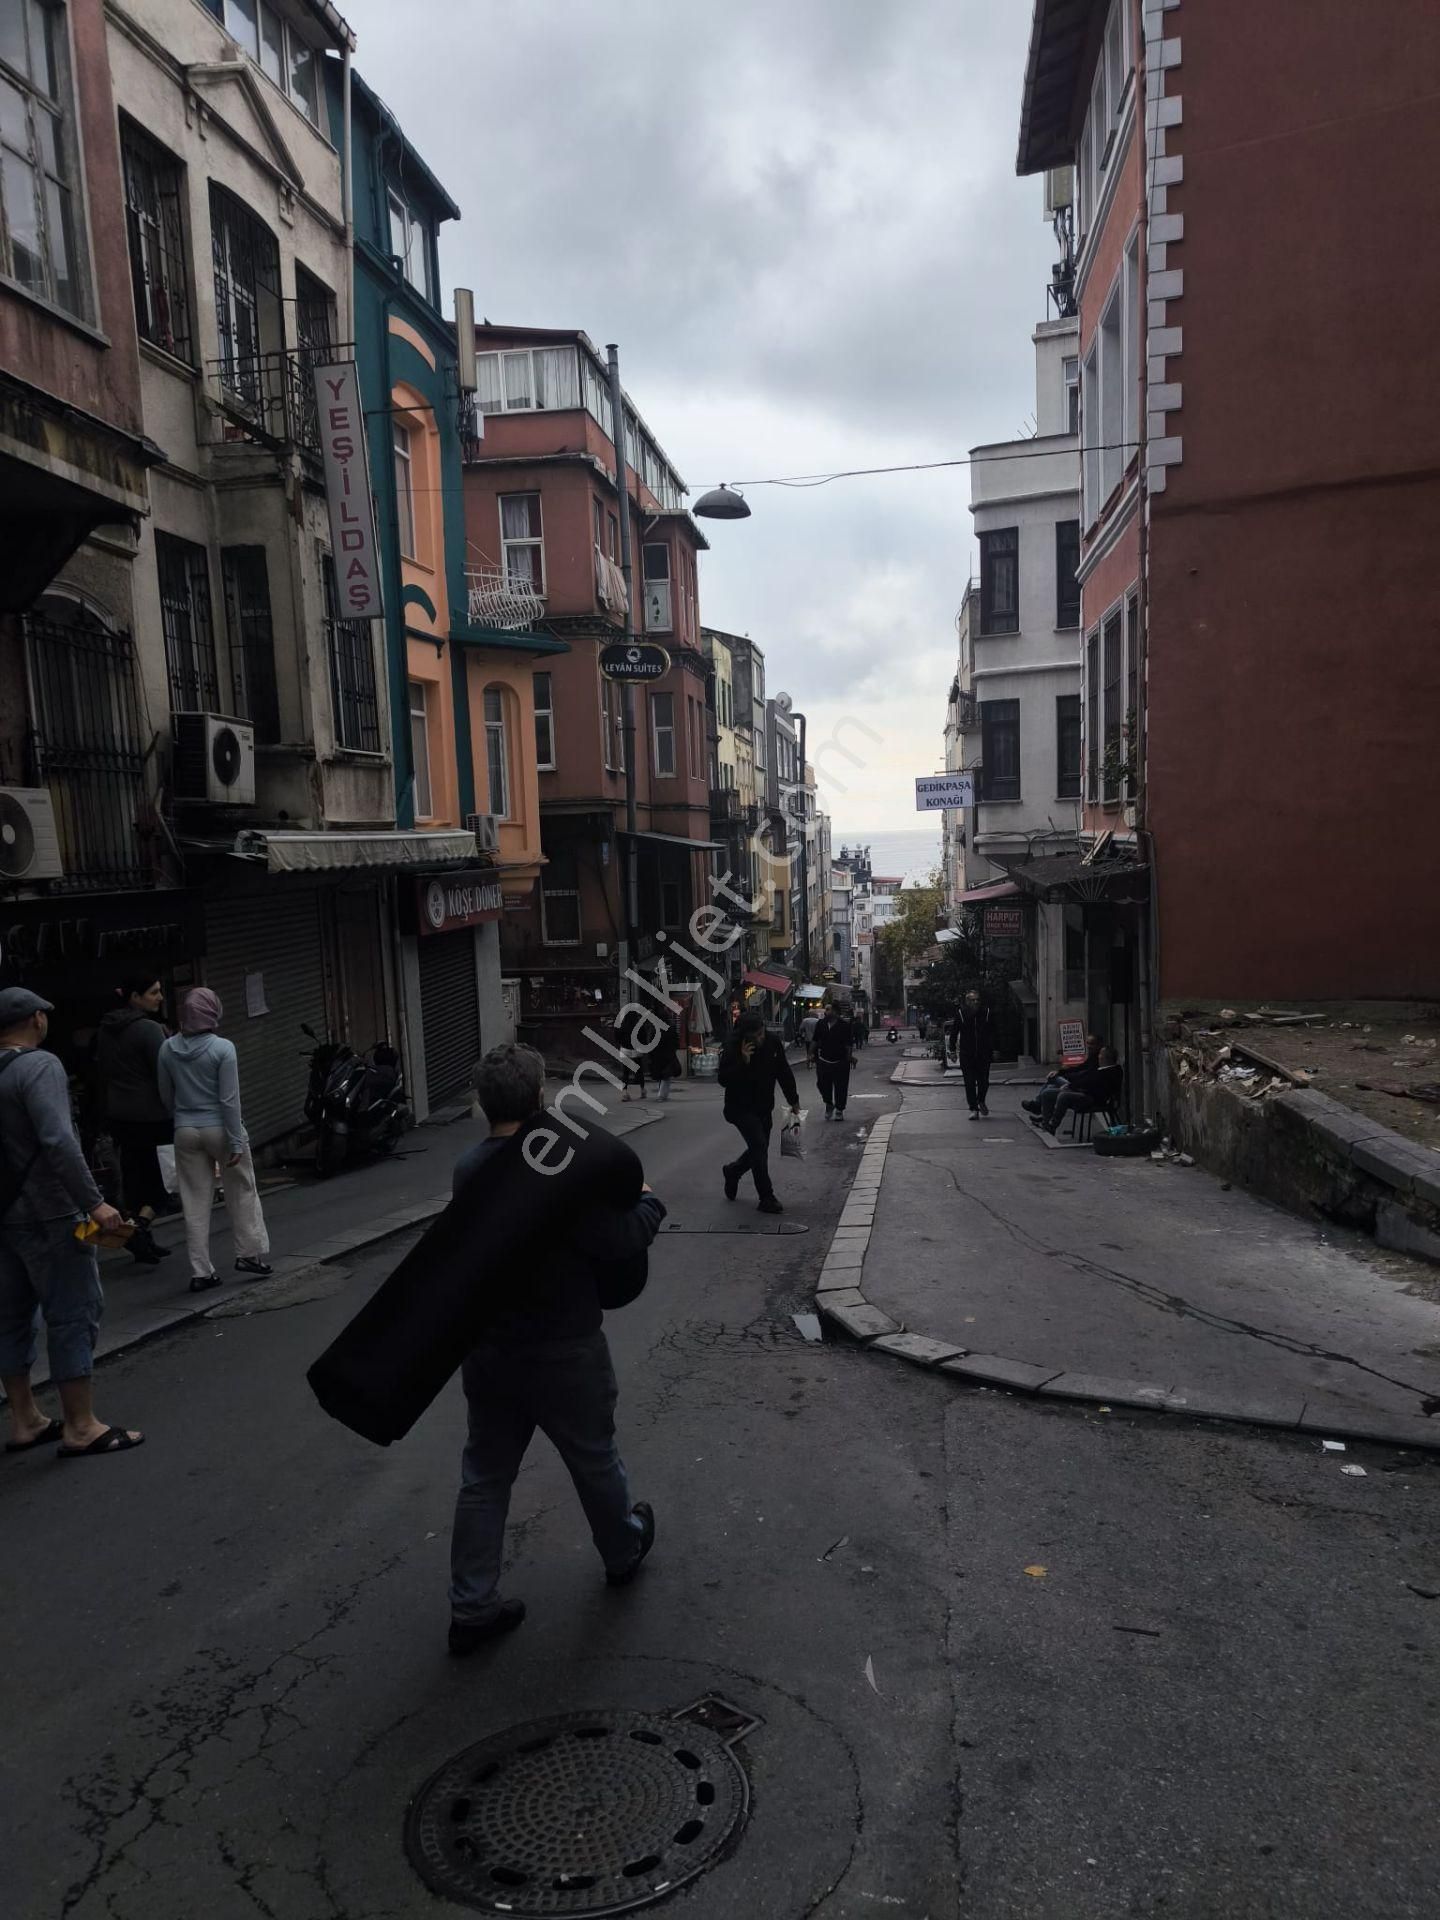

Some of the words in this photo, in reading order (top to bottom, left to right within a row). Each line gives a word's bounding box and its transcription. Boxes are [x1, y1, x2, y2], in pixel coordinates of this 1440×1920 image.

[326, 378, 370, 611] YEŞİLDAŞ
[917, 781, 971, 793] GEDİKPAŞA
[926, 795, 963, 807] KONAĞI
[987, 912, 1020, 921] HARPUT
